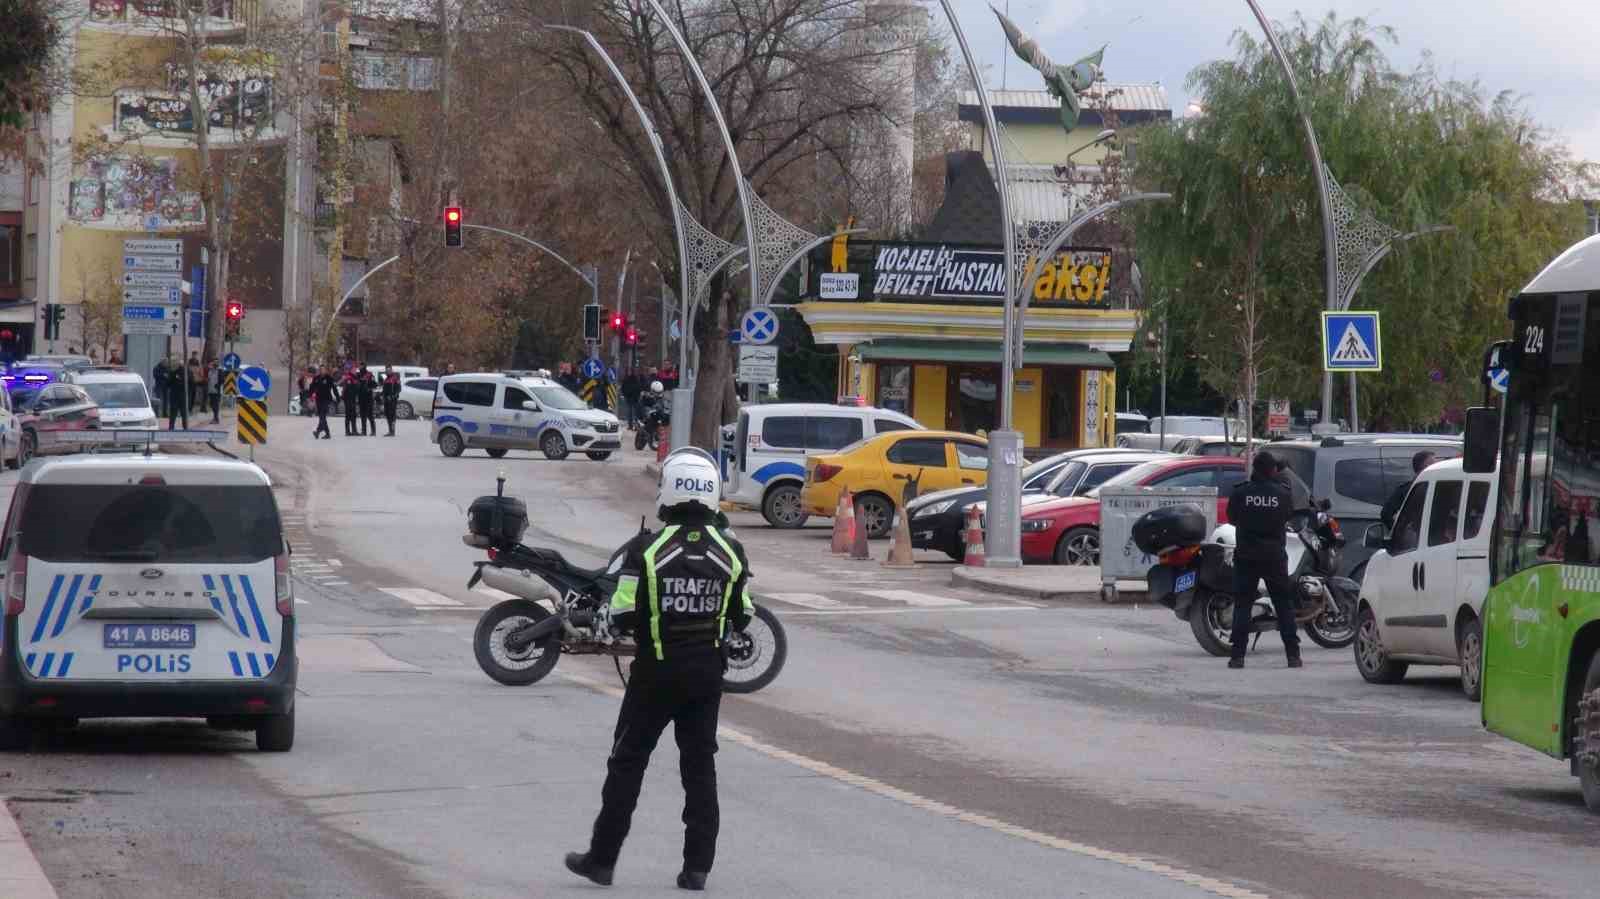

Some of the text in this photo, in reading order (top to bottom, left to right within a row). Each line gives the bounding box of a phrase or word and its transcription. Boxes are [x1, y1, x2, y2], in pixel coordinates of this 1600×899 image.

[873, 261, 1006, 295] DEVLET HASTAN
[1525, 326, 1544, 353] 224
[111, 628, 190, 642] 41 A 8646
